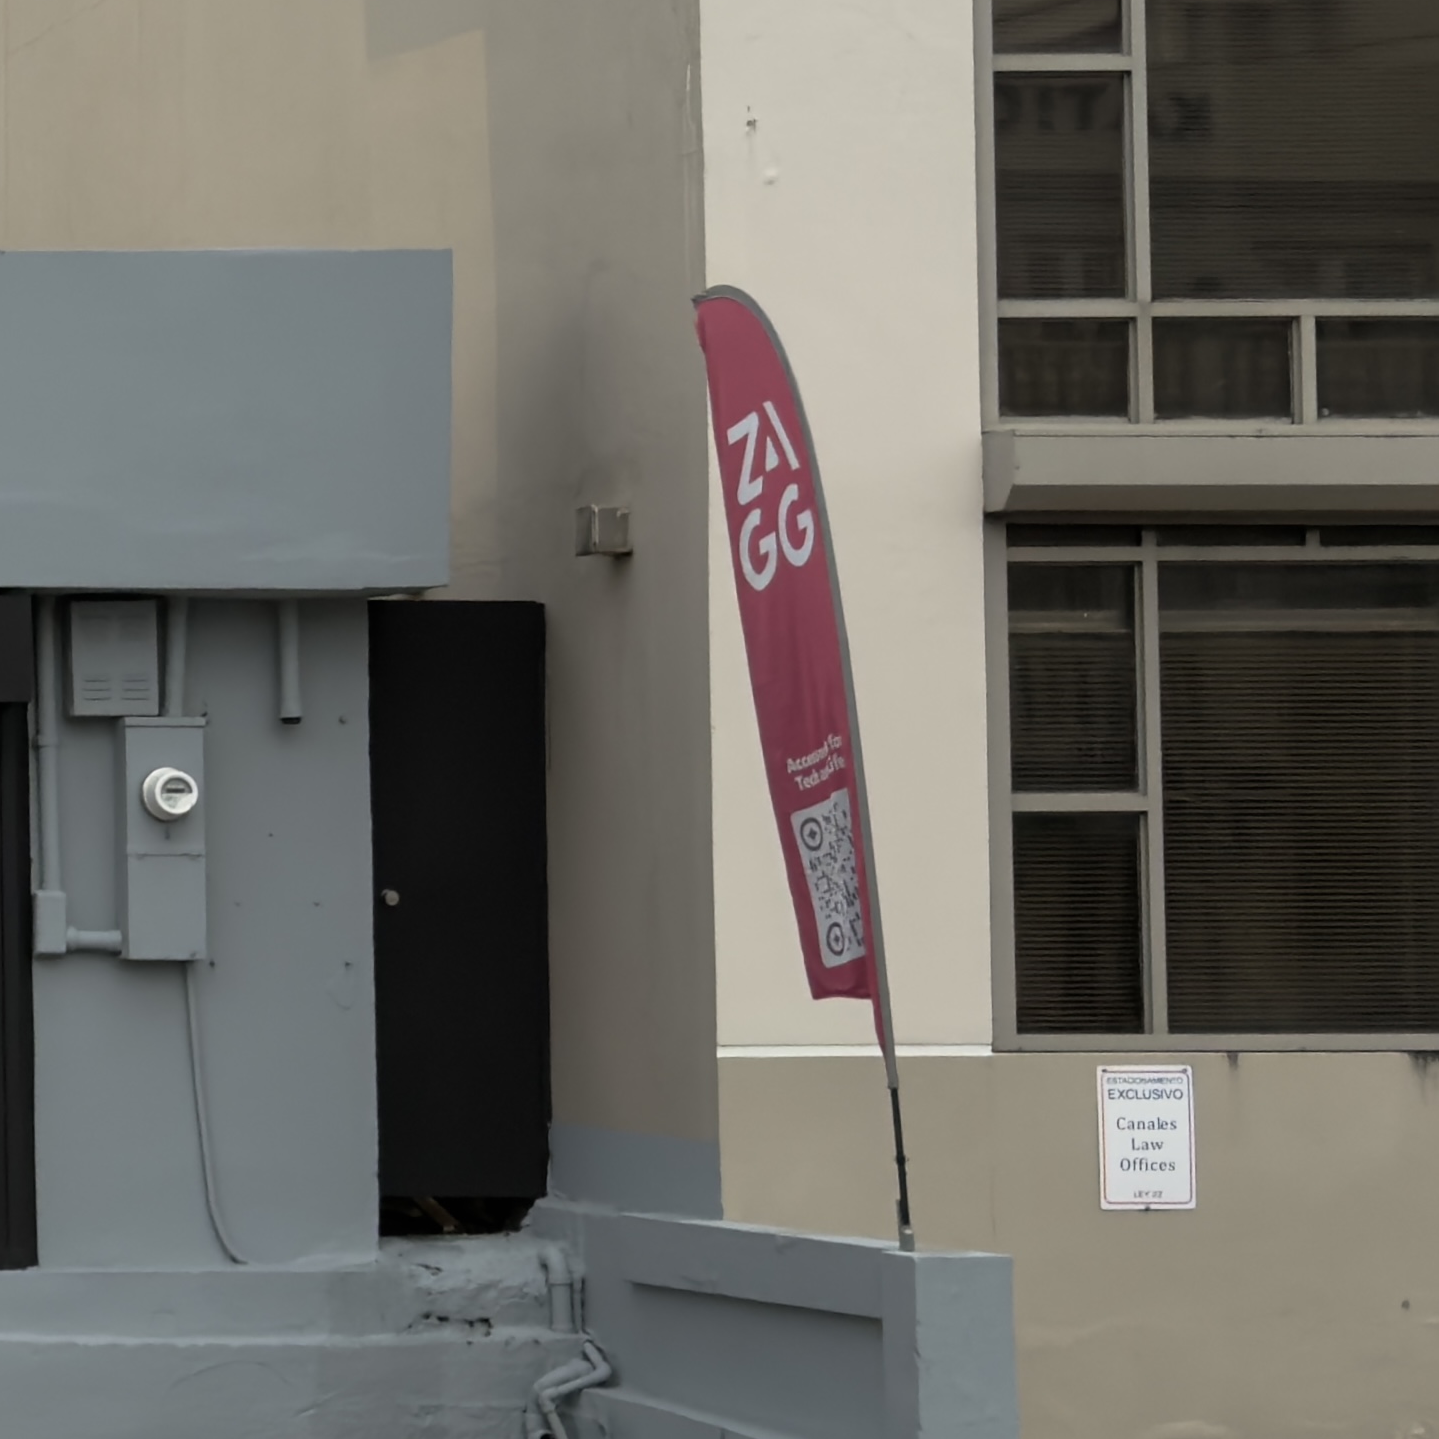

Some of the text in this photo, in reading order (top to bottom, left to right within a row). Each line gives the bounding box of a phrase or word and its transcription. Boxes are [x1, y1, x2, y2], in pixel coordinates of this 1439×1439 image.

[1108, 1088, 1184, 1100] EXCLUSIVO
[1116, 1116, 1177, 1131] Canales
[1131, 1137, 1164, 1151] Law
[1119, 1157, 1176, 1172] Offices
